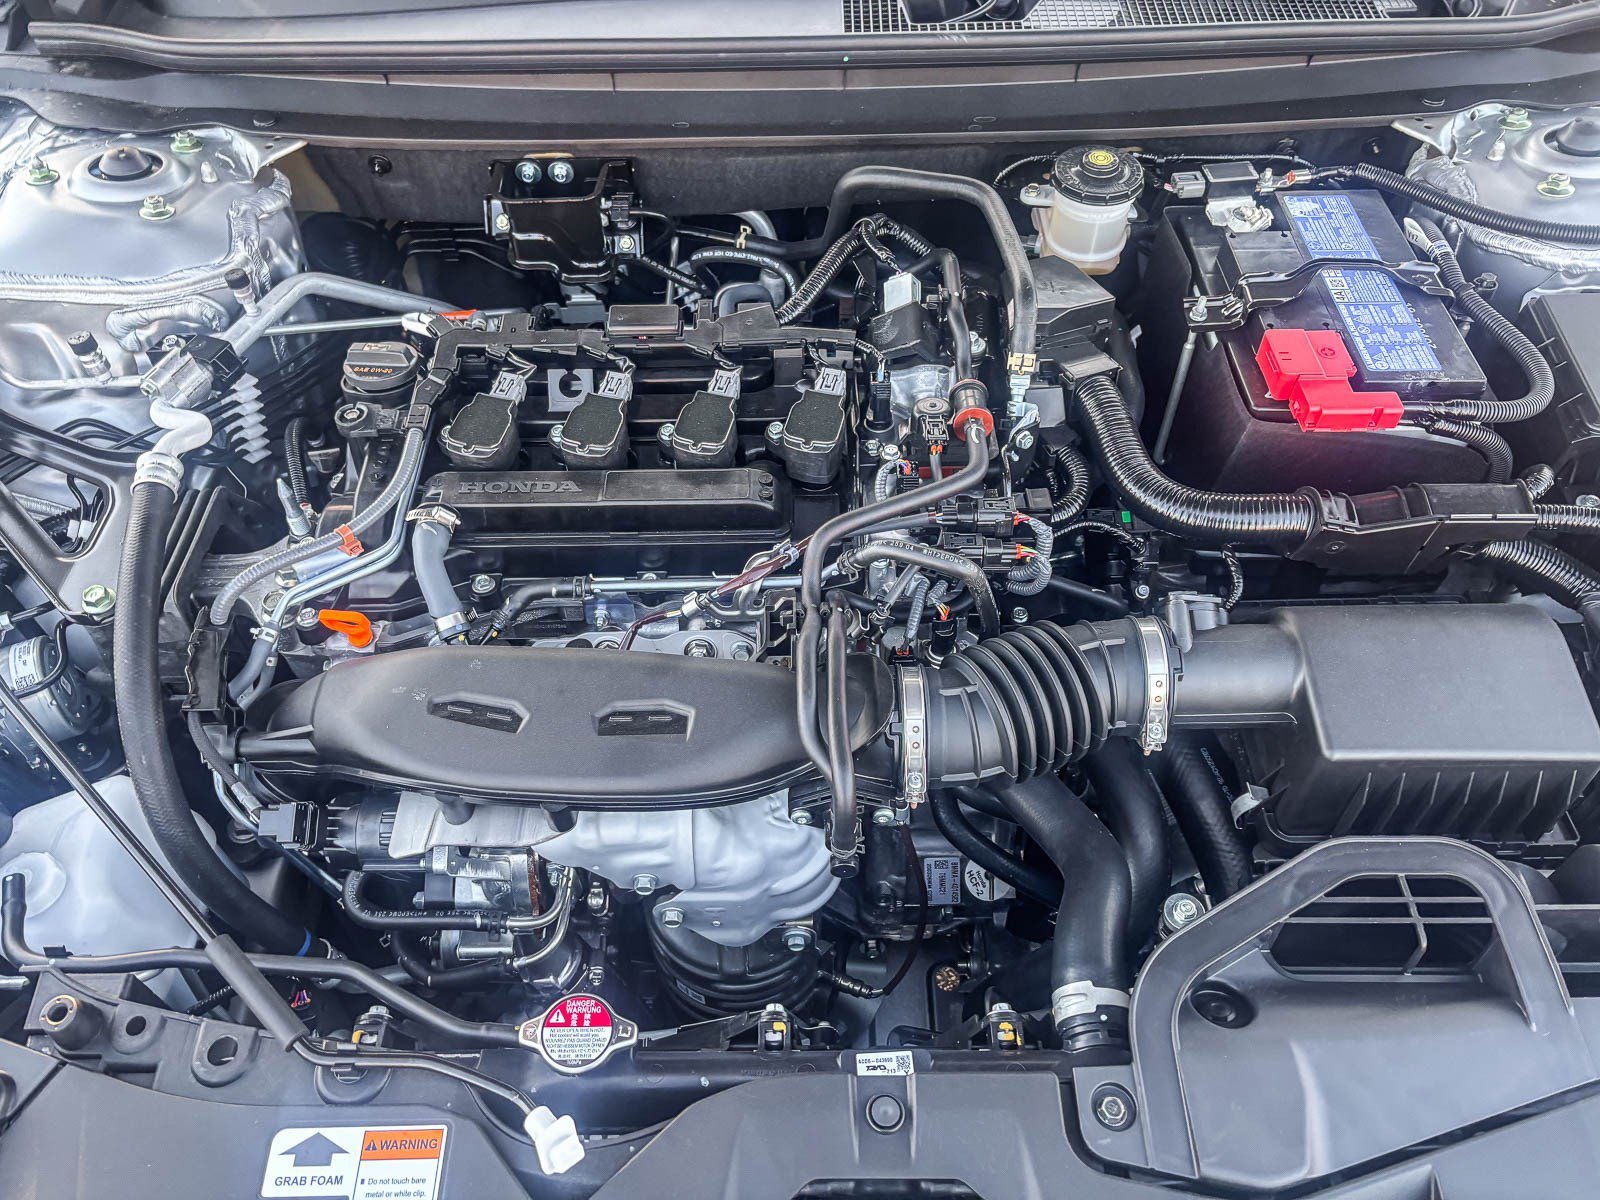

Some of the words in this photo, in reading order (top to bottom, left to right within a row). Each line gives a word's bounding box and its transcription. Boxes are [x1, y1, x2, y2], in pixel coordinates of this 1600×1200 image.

[458, 480, 582, 494] HONDA
[966, 869, 984, 897] HCF-2
[975, 870, 987, 889] Honda
[566, 1006, 602, 1014] WARNUNG
[380, 1138, 438, 1151] WARNING
[274, 1175, 307, 1187] GRAB
[310, 1175, 343, 1186] FOAM
[391, 1177, 410, 1185] touch
[411, 1177, 426, 1185] bare
[365, 1190, 384, 1198] metal
[394, 1190, 412, 1198] white
[413, 1189, 426, 1199] clip.
